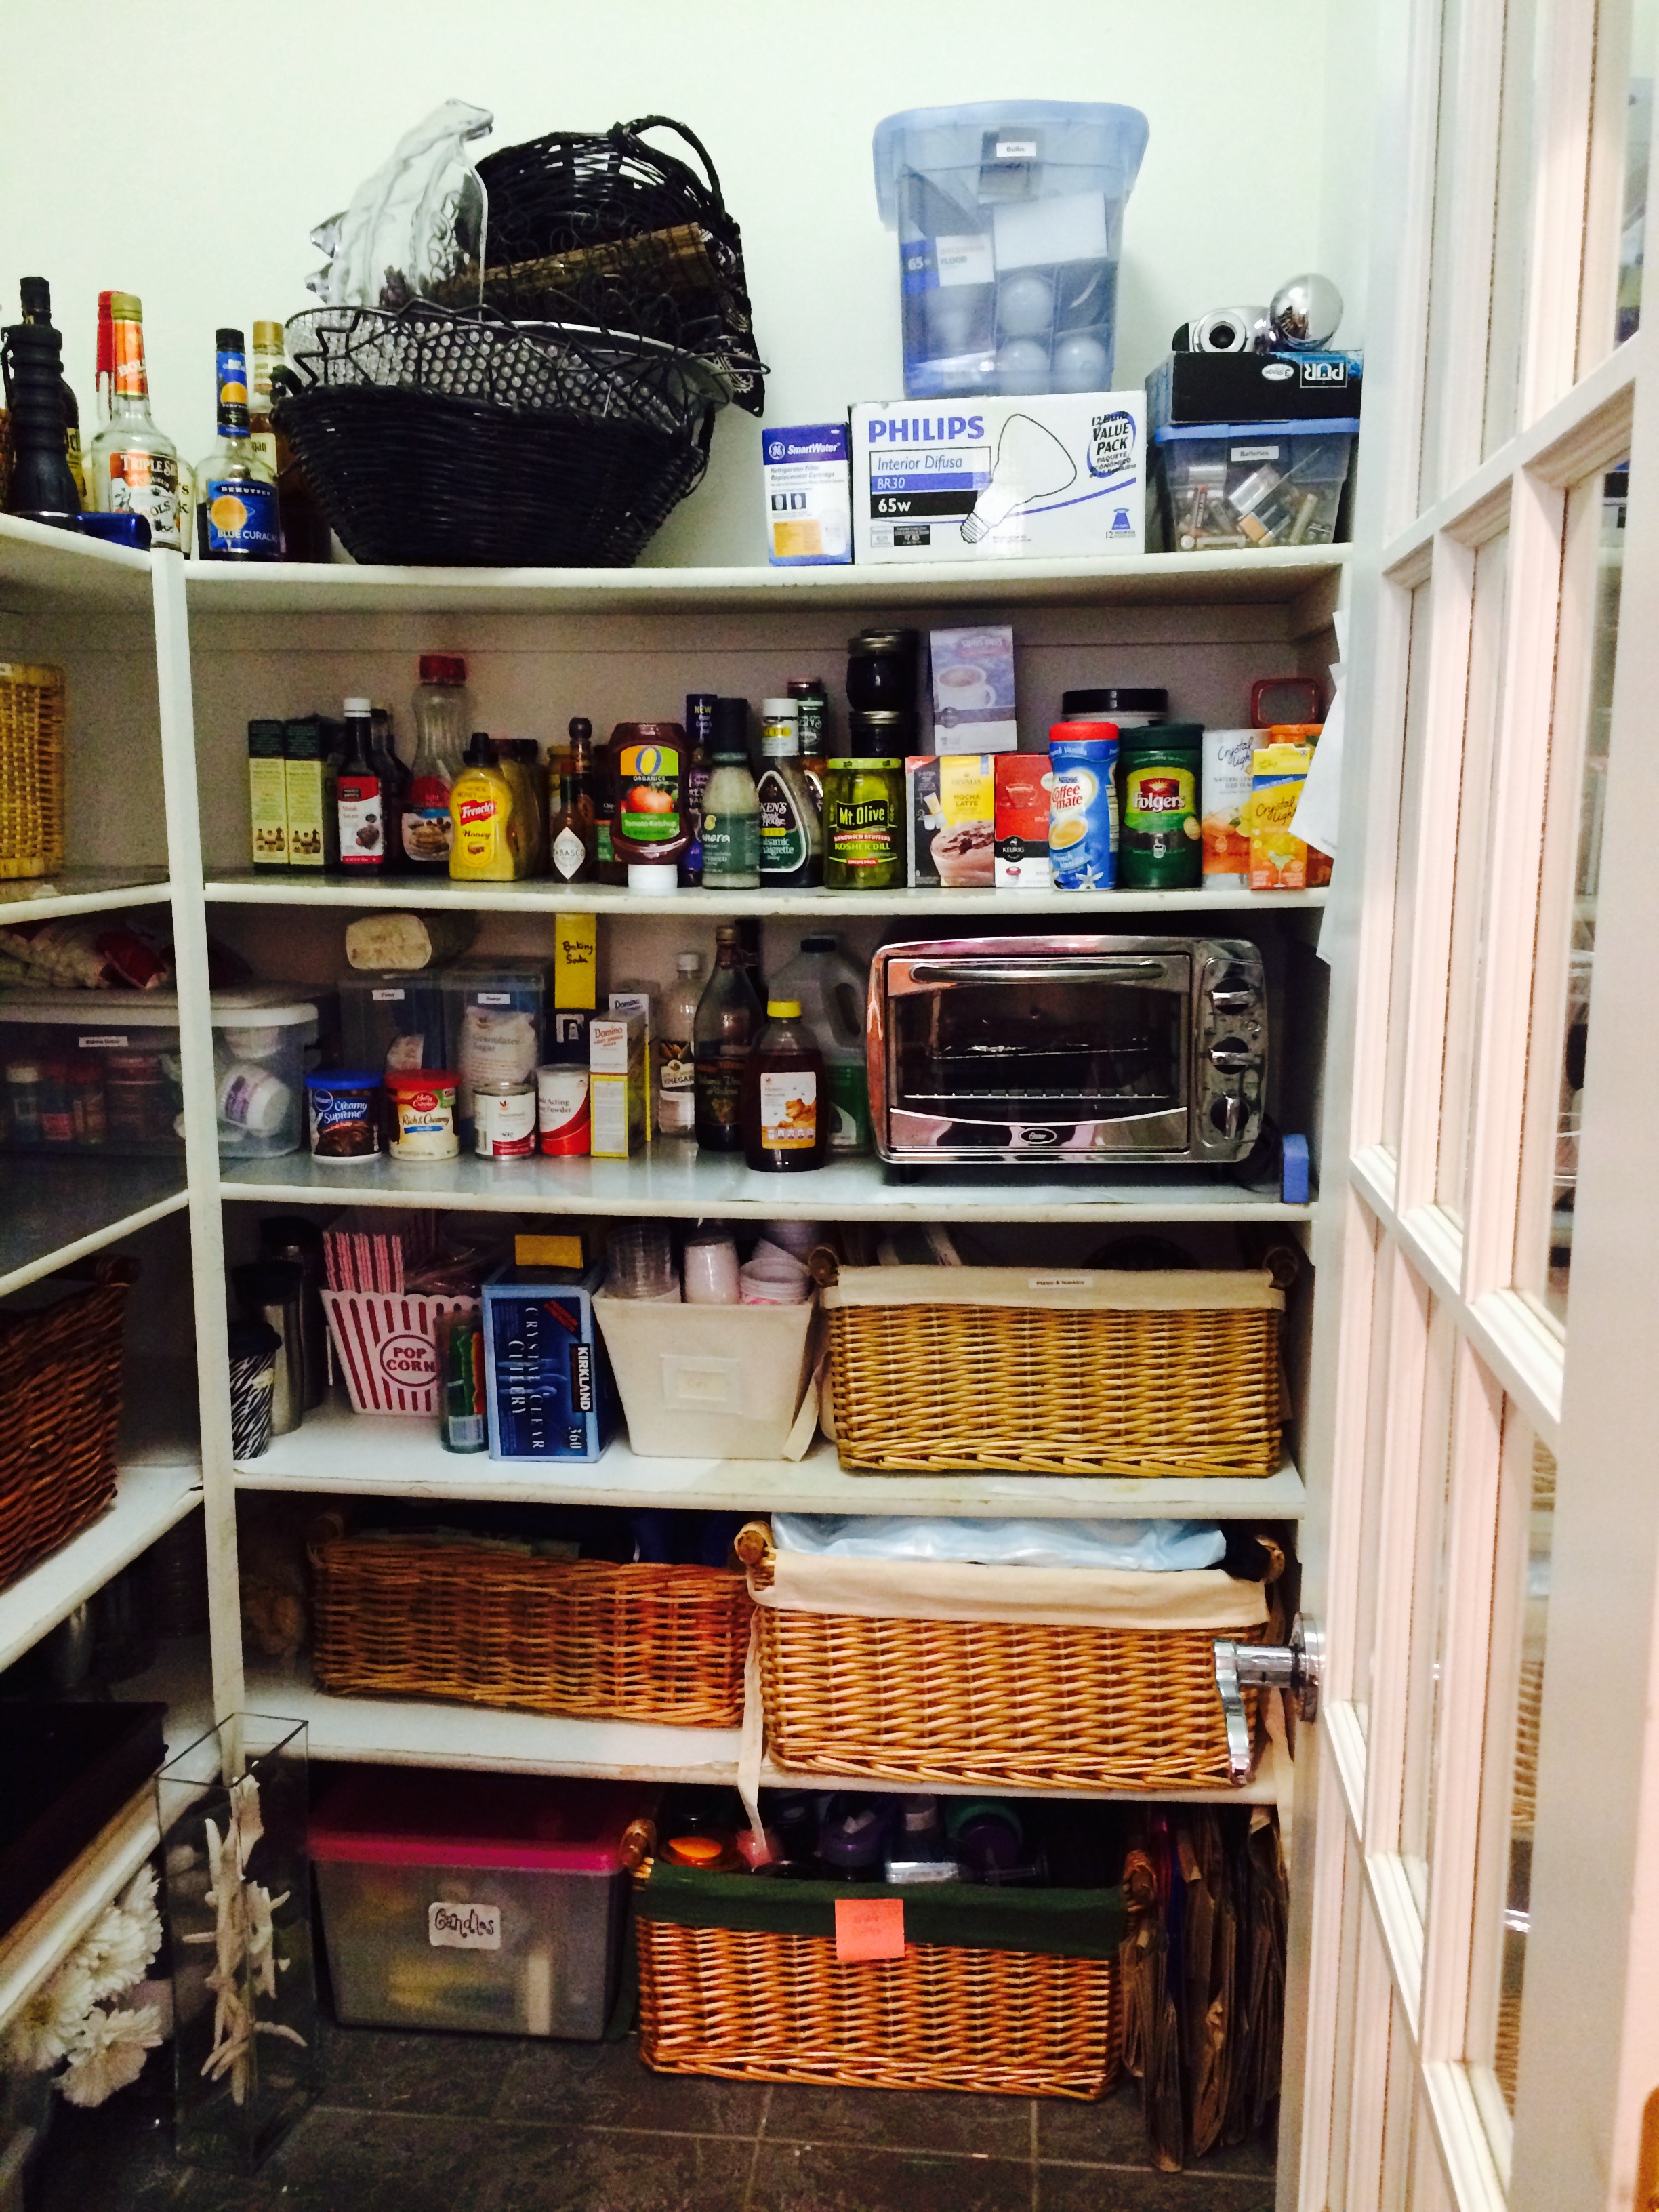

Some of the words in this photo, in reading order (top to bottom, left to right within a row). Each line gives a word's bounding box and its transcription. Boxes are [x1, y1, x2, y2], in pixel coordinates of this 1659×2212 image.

[1092, 416, 1102, 426] 12
[869, 415, 985, 443] PHILIPS
[1092, 422, 1130, 441] VALUE
[787, 442, 838, 455] SmartWater
[1096, 437, 1128, 455] PACK
[120, 454, 163, 473] TRIPLE
[878, 456, 921, 470] Interior
[924, 454, 963, 471] Difusa
[1096, 451, 1128, 464] PAQUETE
[877, 476, 906, 489] BR30
[878, 497, 912, 513] 65w
[217, 529, 241, 540] BLUE
[1105, 531, 1113, 539] 12
[694, 705, 712, 714] NEW
[1218, 736, 1254, 761] Crystal
[1052, 784, 1081, 802] Coffee
[760, 802, 787, 814] KEN'S
[1055, 795, 1083, 811] mate
[1133, 791, 1186, 813] Folgers
[1256, 796, 1296, 819] Crystal
[840, 806, 855, 826] Mt.
[856, 805, 886, 825] Olive
[624, 819, 649, 827] Tomato
[649, 819, 678, 829] Ketchup
[872, 842, 891, 850] DILL
[562, 941, 594, 955] Baking
[566, 953, 588, 964] Soda
[614, 998, 640, 1008] Domino
[594, 1027, 623, 1039] Domino
[334, 1101, 368, 1112] Creamy
[548, 1099, 569, 1107] Acting
[402, 1115, 417, 1126] Rich
[423, 1113, 450, 1126] Creamy
[392, 1347, 427, 1359] POP
[386, 1359, 436, 1372] CORN
[577, 1346, 592, 1410] KIRKLAND
